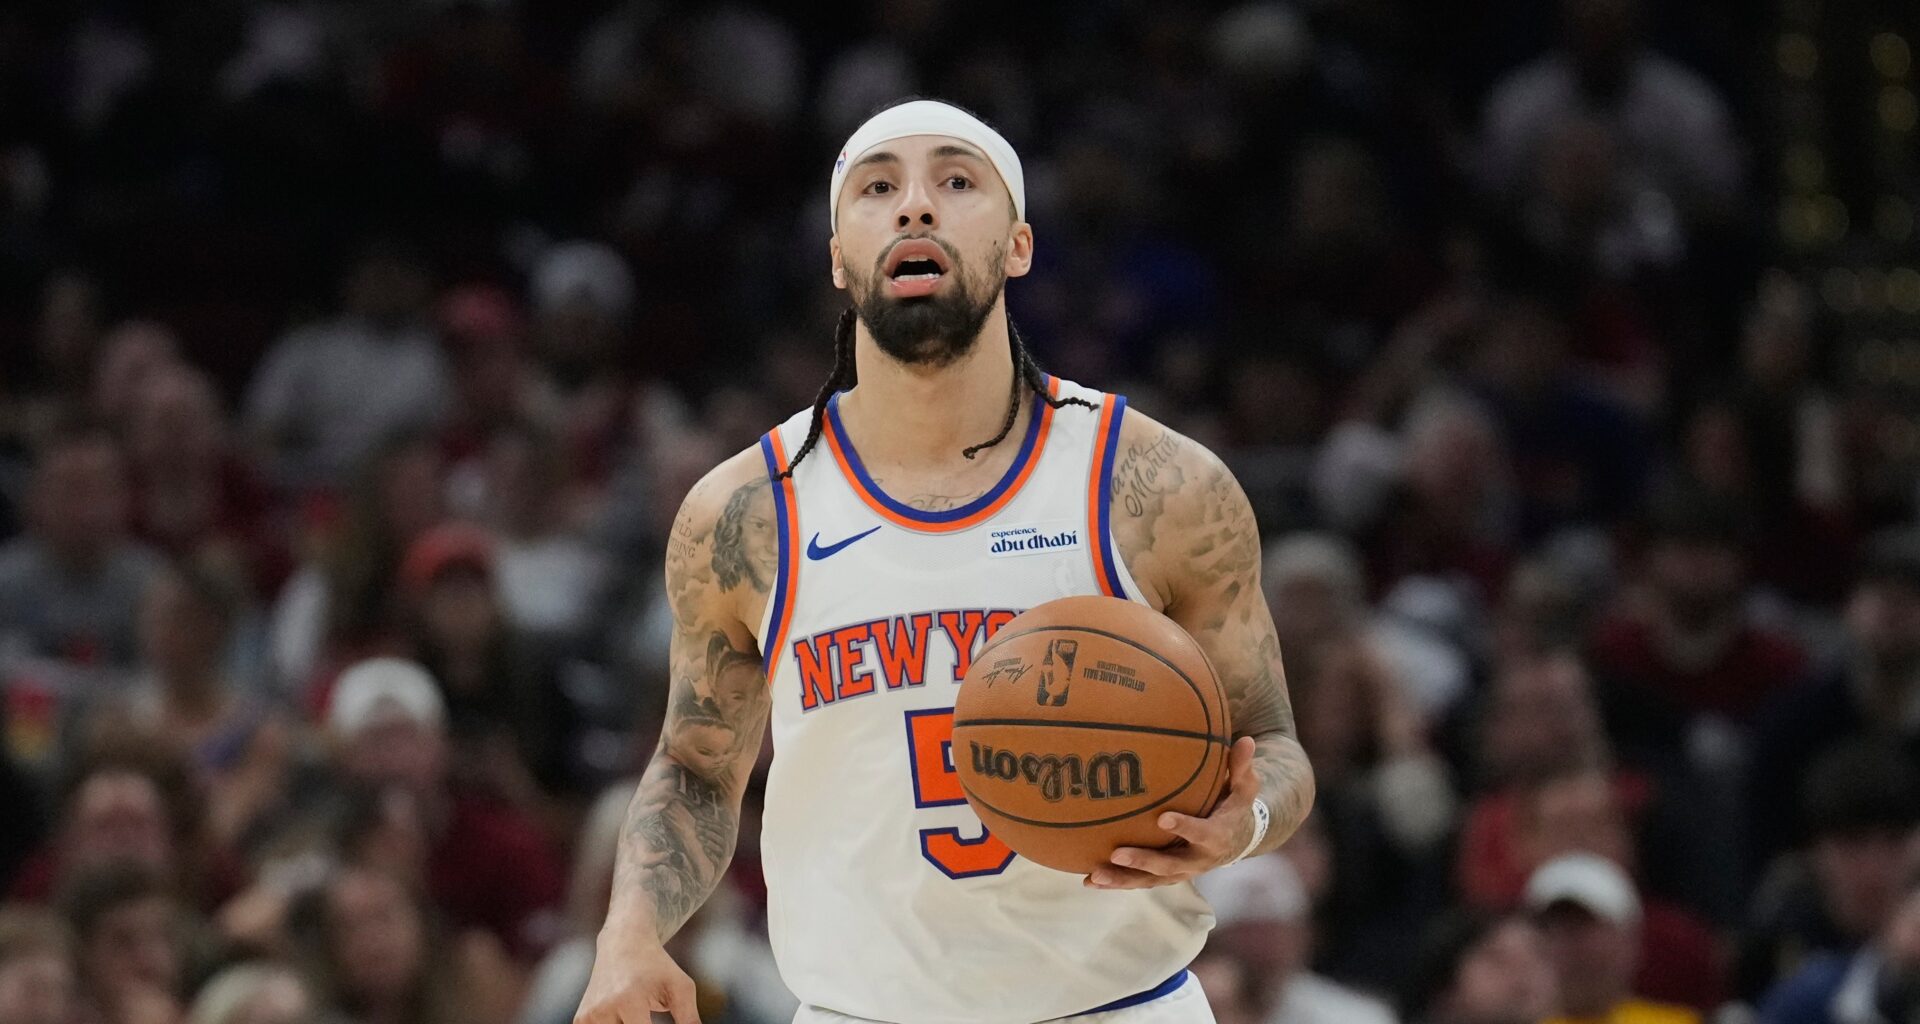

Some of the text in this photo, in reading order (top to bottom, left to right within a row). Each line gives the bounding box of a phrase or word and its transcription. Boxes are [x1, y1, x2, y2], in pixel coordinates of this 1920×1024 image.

[991, 528, 1037, 538] experience
[991, 530, 1078, 553] abu dhabi
[791, 612, 933, 714] NEW
[904, 706, 1018, 880] 5
[969, 740, 1147, 803] Wilson
